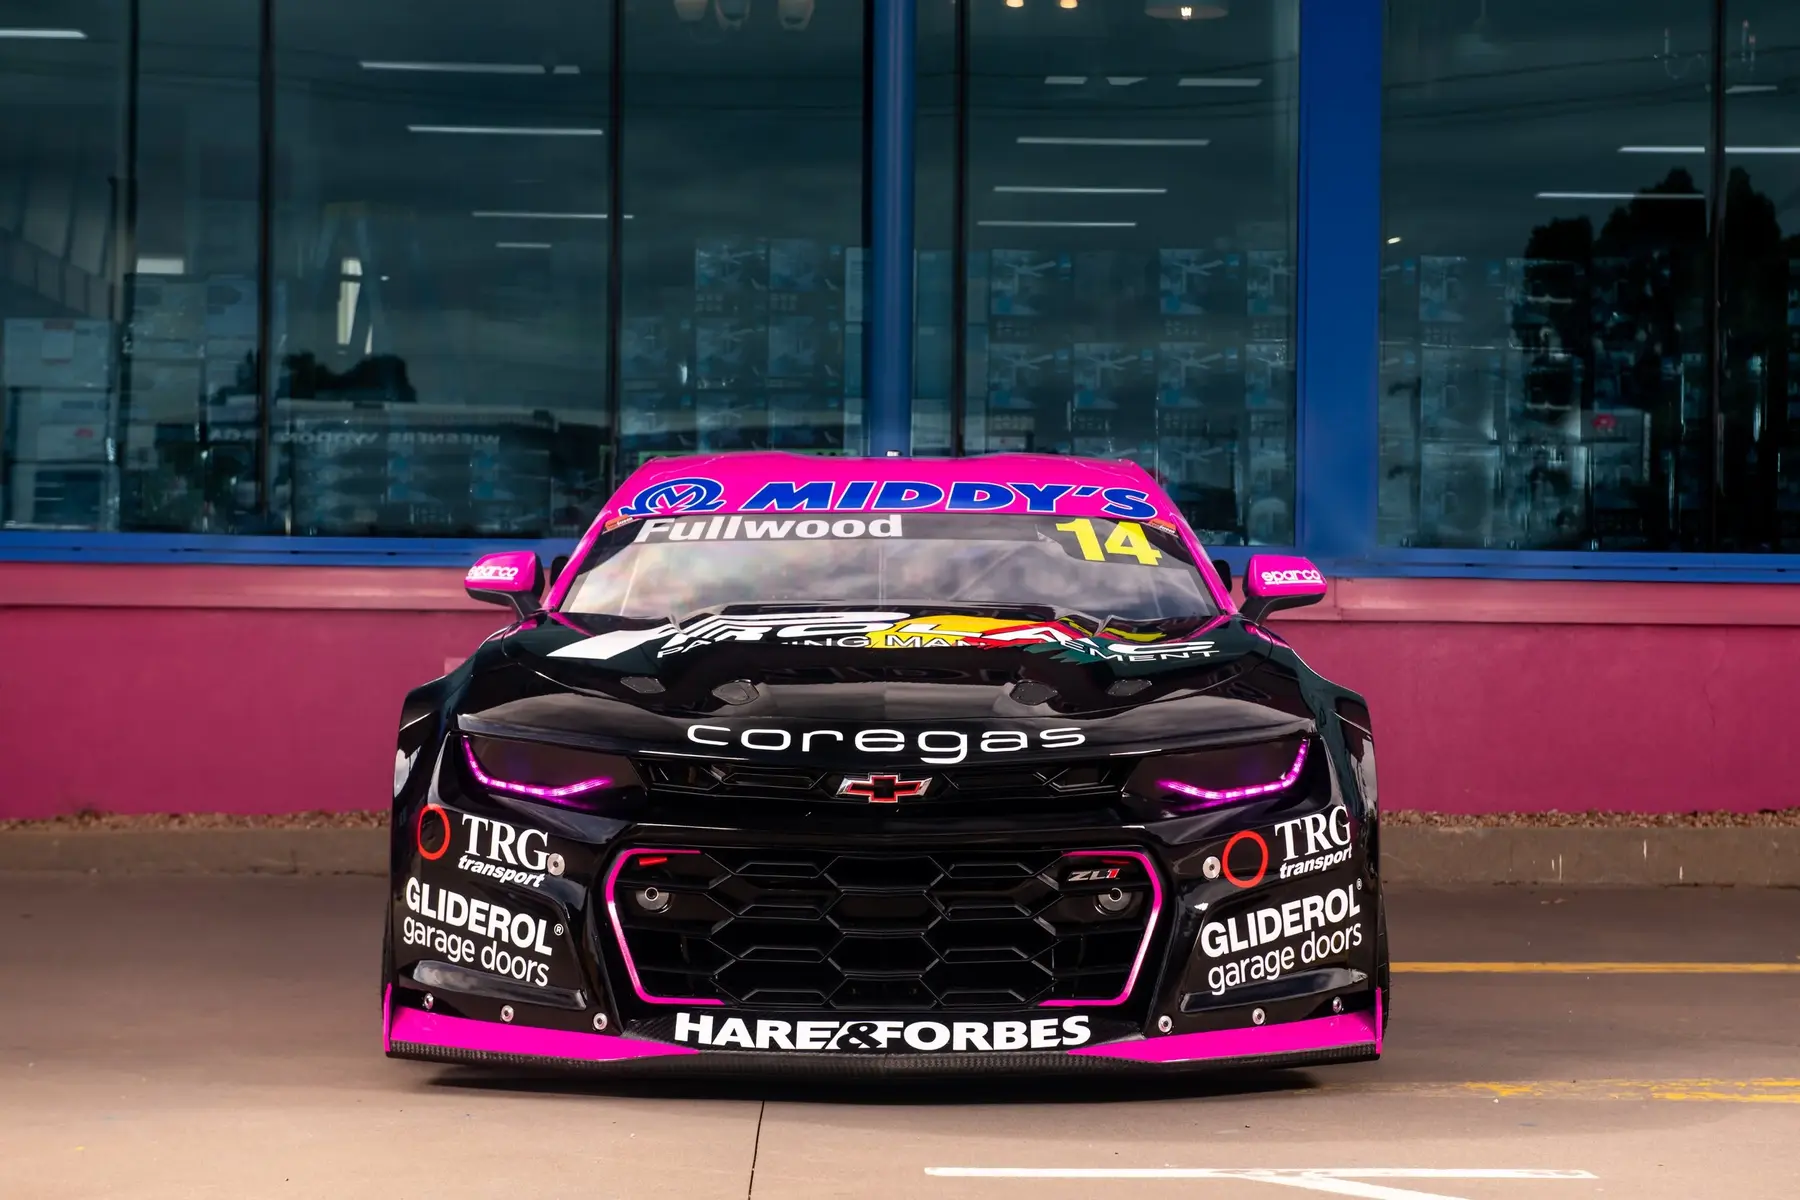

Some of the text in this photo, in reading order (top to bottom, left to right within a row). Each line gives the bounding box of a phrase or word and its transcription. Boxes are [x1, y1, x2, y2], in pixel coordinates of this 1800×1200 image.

[737, 479, 1157, 521] MIDDY'S
[634, 514, 905, 543] Fullwood
[1055, 518, 1163, 566] 14
[1260, 569, 1322, 585] sparco
[686, 724, 1086, 764] coregas
[461, 813, 550, 871] TRG
[1274, 804, 1351, 862] TRG
[457, 854, 545, 888] transport
[1068, 868, 1121, 882] ZL1
[1279, 843, 1353, 880] transport
[402, 915, 550, 988] garage doors
[1207, 919, 1363, 996] garage doors
